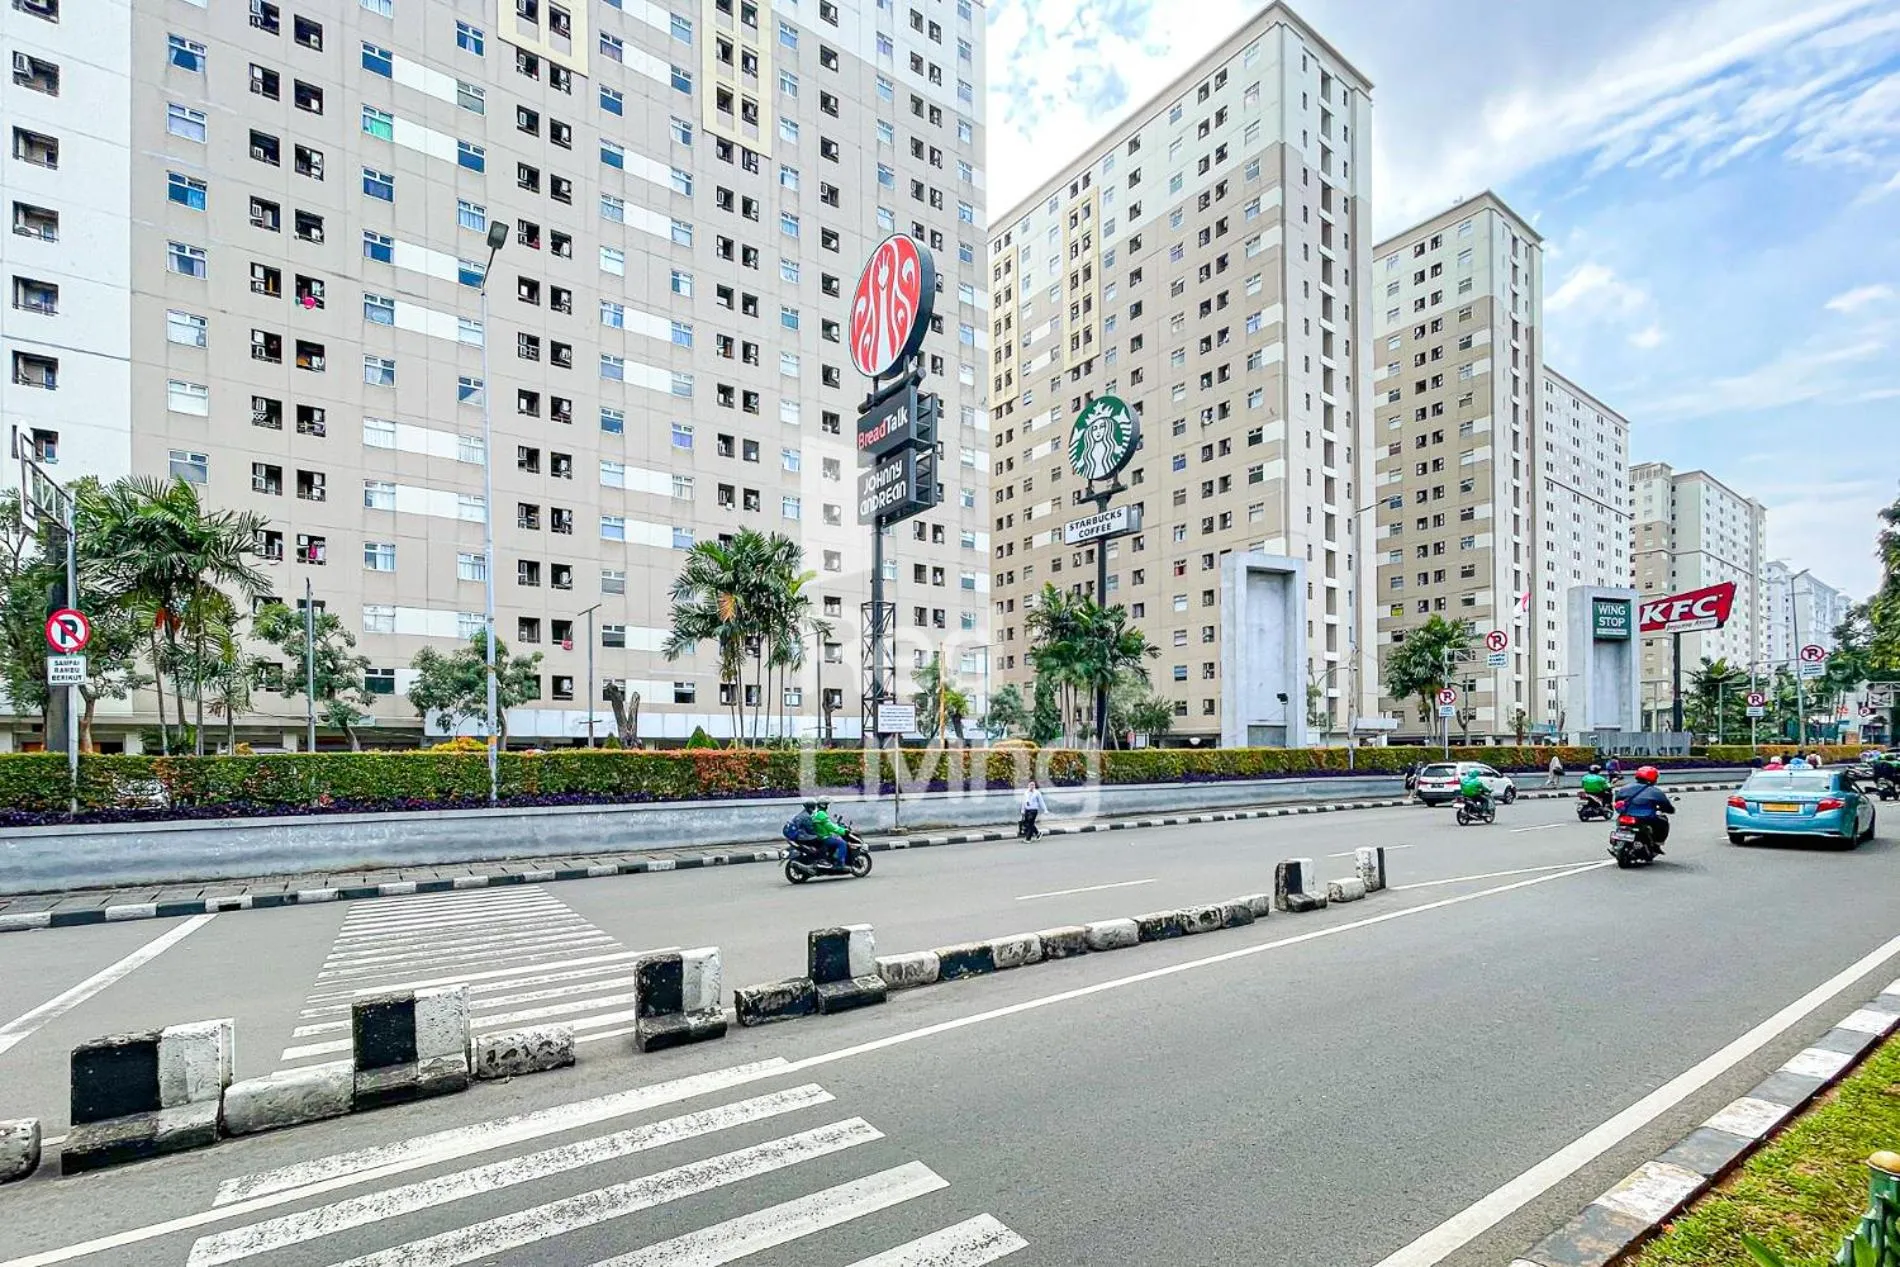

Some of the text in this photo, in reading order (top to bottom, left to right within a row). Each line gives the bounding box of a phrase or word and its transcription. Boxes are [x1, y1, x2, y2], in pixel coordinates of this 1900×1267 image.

[858, 406, 908, 450] BreadTalk
[1069, 508, 1122, 532] STARBUCKS
[1078, 522, 1112, 538] COFFEE
[1598, 604, 1626, 616] WING
[1640, 594, 1719, 624] KFC
[1598, 616, 1626, 627] STOP
